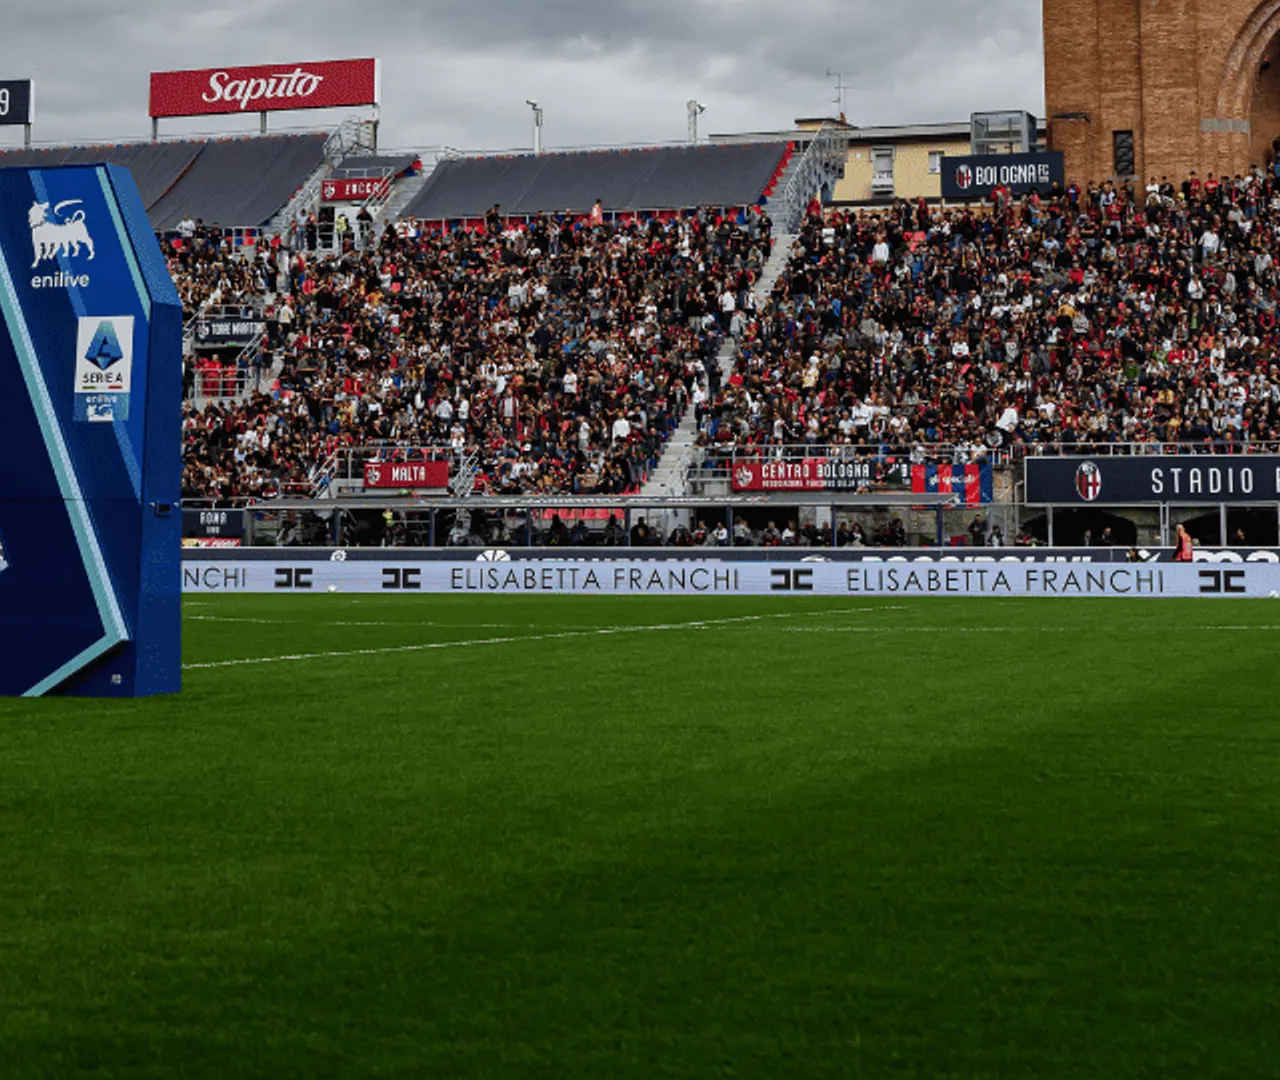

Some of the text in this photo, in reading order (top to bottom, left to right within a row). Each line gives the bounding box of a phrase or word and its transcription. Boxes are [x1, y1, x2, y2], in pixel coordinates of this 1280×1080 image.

[201, 67, 324, 110] Saputo
[975, 163, 1037, 186] BOLOGNA
[30, 270, 90, 289] enilive
[391, 466, 427, 482] MALTA
[761, 463, 810, 478] CENTRO
[816, 463, 870, 478] BOLOGNA
[1150, 467, 1254, 494] STADIO
[183, 567, 246, 589] NCHI
[450, 568, 739, 590] ELISABETTA FRANCHI
[846, 568, 1164, 594] ELISABETTA FRANCHI
